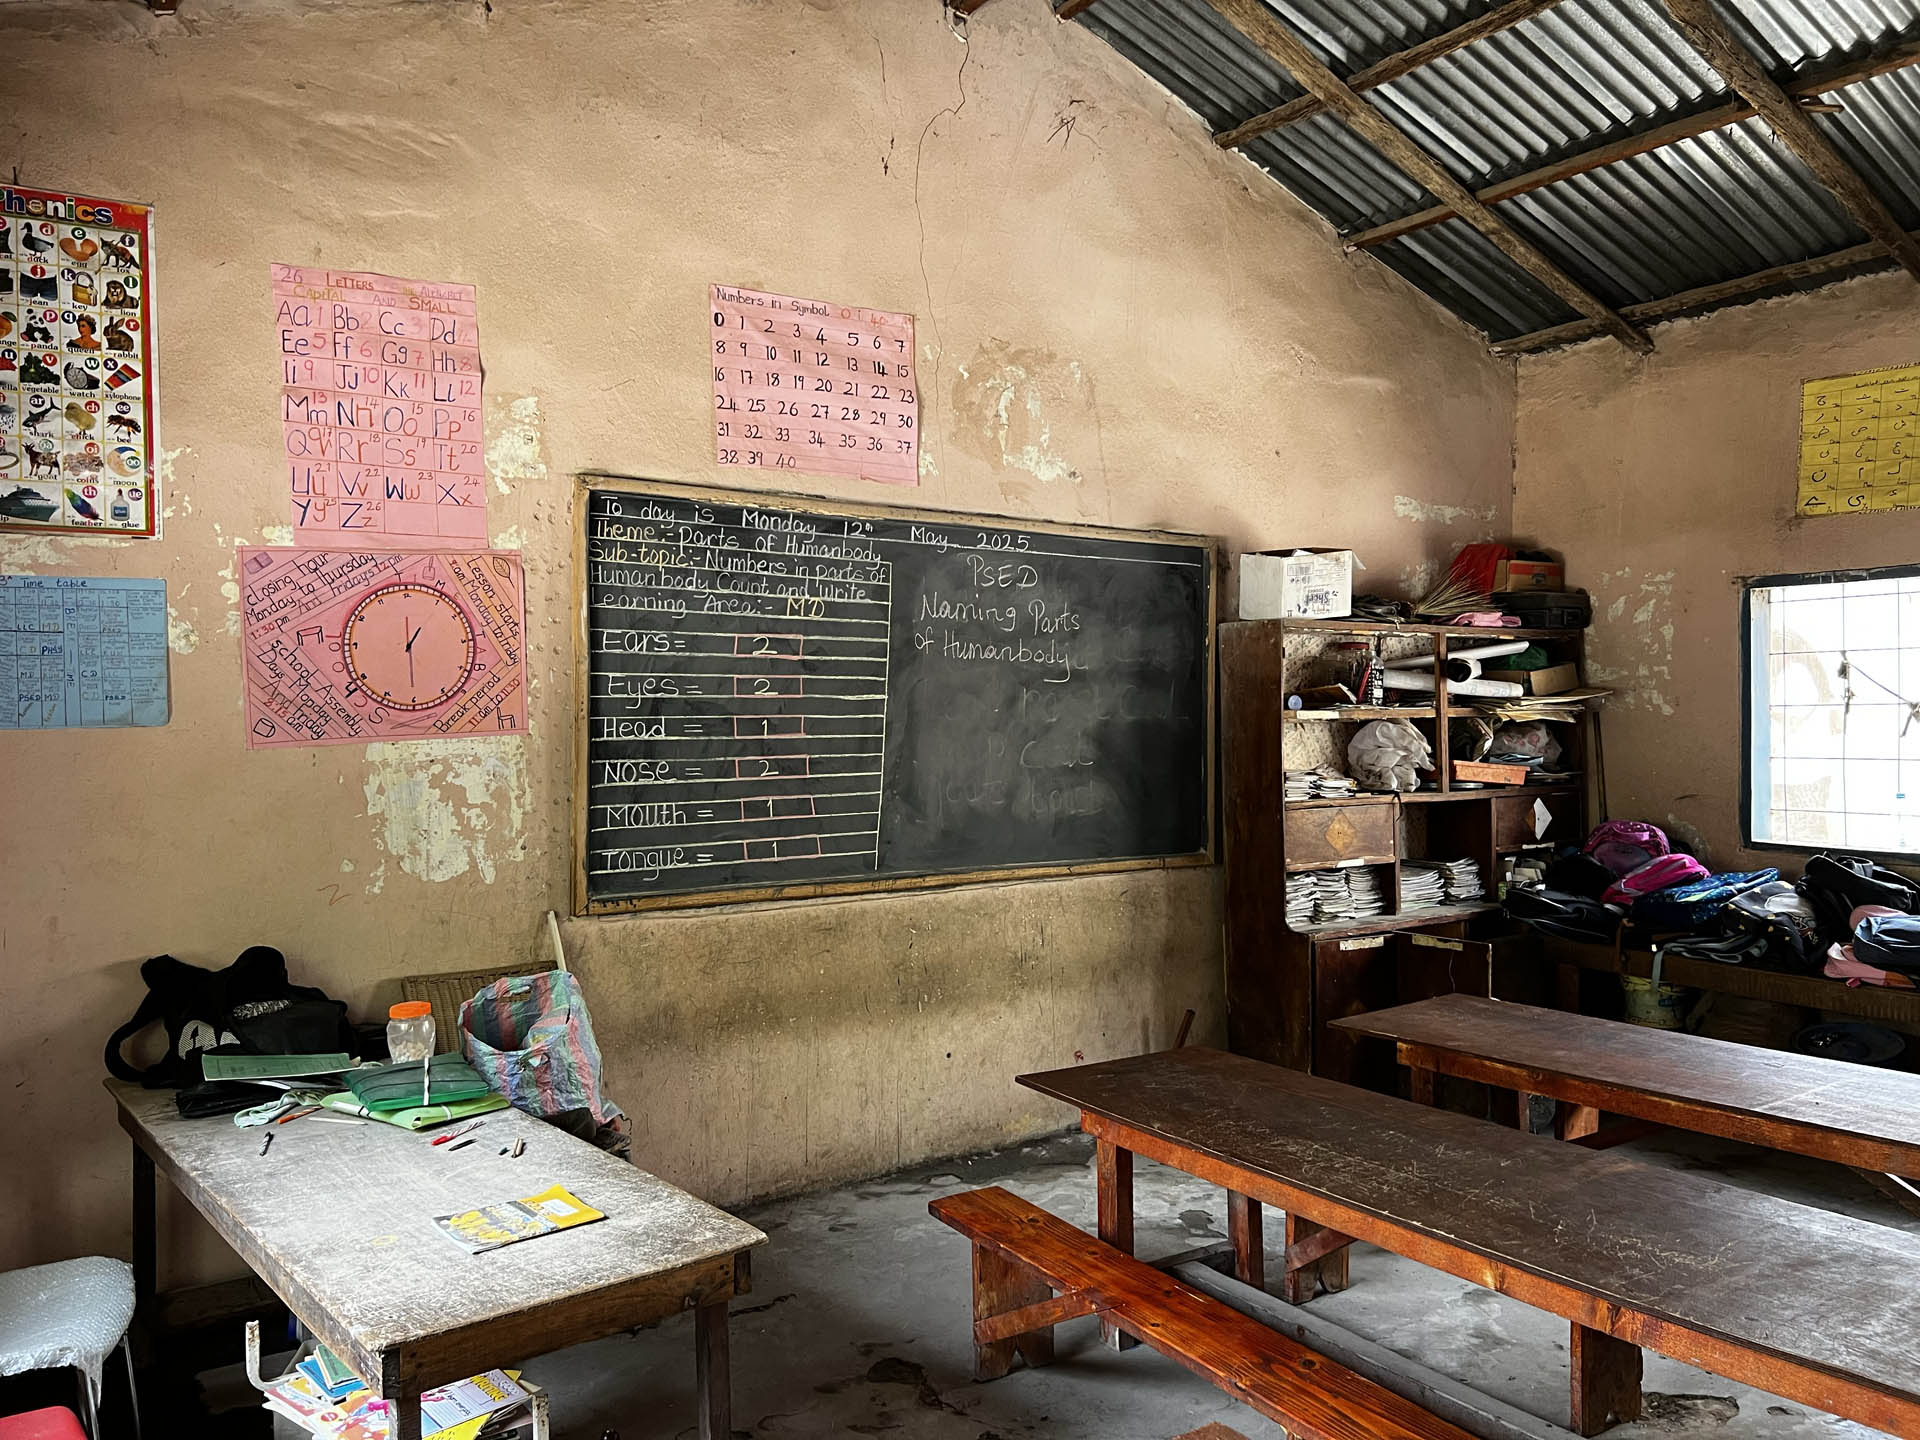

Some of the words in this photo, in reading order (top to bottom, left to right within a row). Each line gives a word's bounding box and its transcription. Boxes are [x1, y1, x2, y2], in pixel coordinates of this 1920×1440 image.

[0, 188, 113, 225] honics
[279, 266, 303, 284] 26
[72, 302, 88, 311] key
[120, 308, 137, 317] lion
[716, 287, 764, 306] Numbers
[771, 298, 782, 309] in
[791, 300, 830, 317] Symbol
[714, 312, 724, 327] 0
[764, 319, 776, 333] 2
[793, 324, 801, 338] 3
[816, 328, 827, 345] 4
[847, 332, 859, 347] 5
[873, 336, 881, 349] 6
[894, 340, 905, 353] 7
[31, 342, 58, 351] panda
[67, 347, 95, 355] queen
[113, 352, 139, 360] rabbit
[21, 385, 60, 395] vegetable
[69, 390, 96, 399] watch
[105, 392, 142, 402] xylophone
[716, 395, 739, 413] 24
[747, 399, 766, 413] 25
[778, 401, 799, 416] 26
[811, 404, 830, 419] 27
[841, 407, 860, 421] 28
[870, 411, 886, 426] 29
[898, 415, 913, 429] 30
[719, 449, 739, 464] 38
[747, 451, 763, 466] 39
[776, 454, 796, 469] 40
[71, 519, 102, 528] feather
[121, 521, 140, 529] glue
[694, 504, 715, 523] is
[741, 508, 816, 543] Monday
[911, 525, 950, 553] May
[977, 532, 1031, 551] 2025
[291, 552, 329, 577] hour
[705, 549, 787, 574] Numbers
[794, 557, 809, 579] in
[870, 568, 888, 583] of
[967, 554, 1039, 589] PSED
[466, 555, 496, 599] Lesson
[717, 572, 769, 595] Count
[776, 578, 810, 599] and
[245, 595, 297, 627] Monday
[315, 553, 378, 588] Thursday
[463, 579, 495, 628] Monday
[591, 587, 687, 618] Learning
[787, 597, 825, 618] MD
[920, 592, 1017, 632] Naming
[1029, 599, 1080, 635] Parts
[275, 615, 290, 633] pm
[753, 636, 778, 655] 2
[944, 629, 1071, 682] Humanbody
[257, 647, 285, 679] Days
[288, 678, 333, 727] Monday
[754, 678, 779, 696] 2
[314, 684, 363, 737] Assembly
[433, 702, 470, 733] Break
[469, 671, 501, 711] period
[286, 715, 305, 732] am
[603, 716, 666, 738] Head
[761, 719, 769, 737] 1
[759, 759, 779, 777] 2
[767, 798, 773, 818] 1
[601, 847, 689, 881] Tongue
[771, 841, 778, 860] 1
